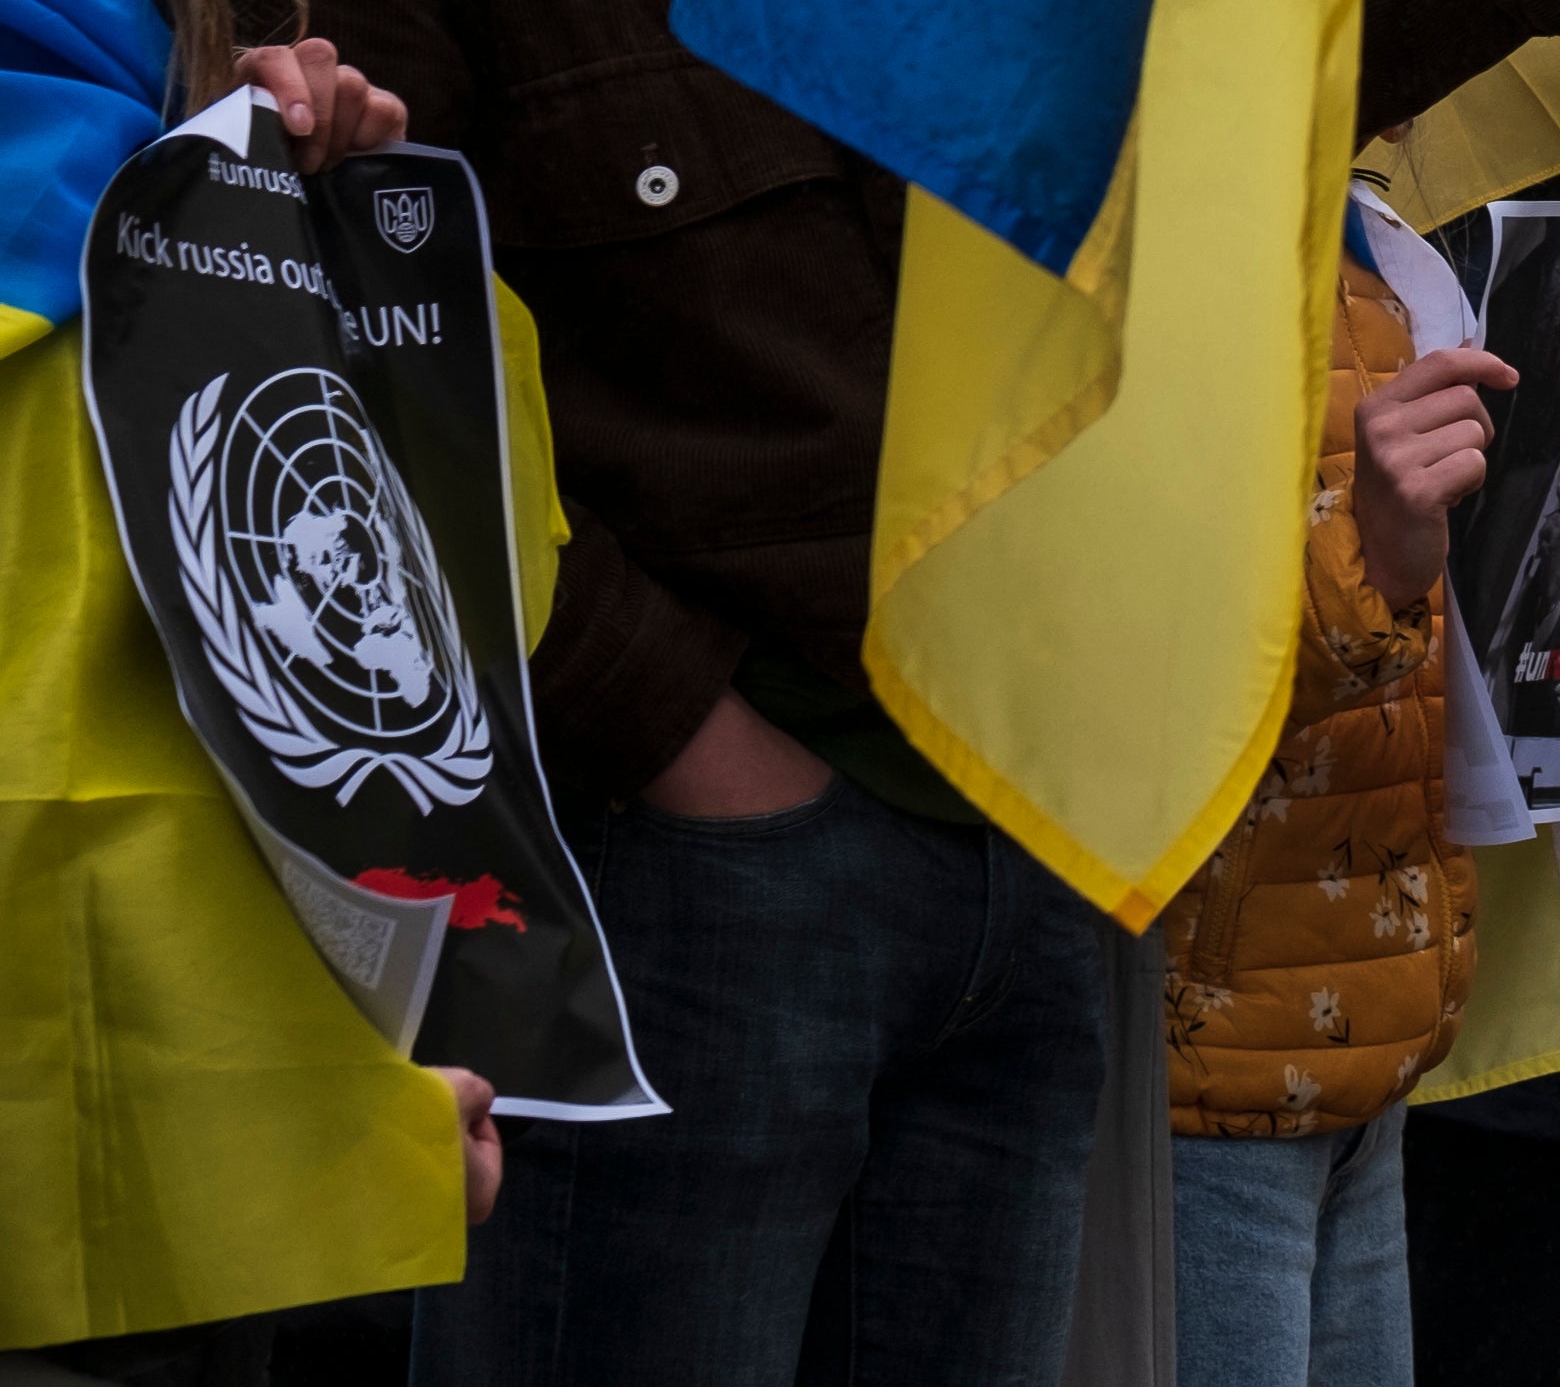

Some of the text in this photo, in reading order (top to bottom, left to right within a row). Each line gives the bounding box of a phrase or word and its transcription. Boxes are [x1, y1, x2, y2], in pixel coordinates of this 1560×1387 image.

[116, 211, 174, 268] Kick
[176, 238, 275, 285] russia
[360, 301, 443, 348] UN!
